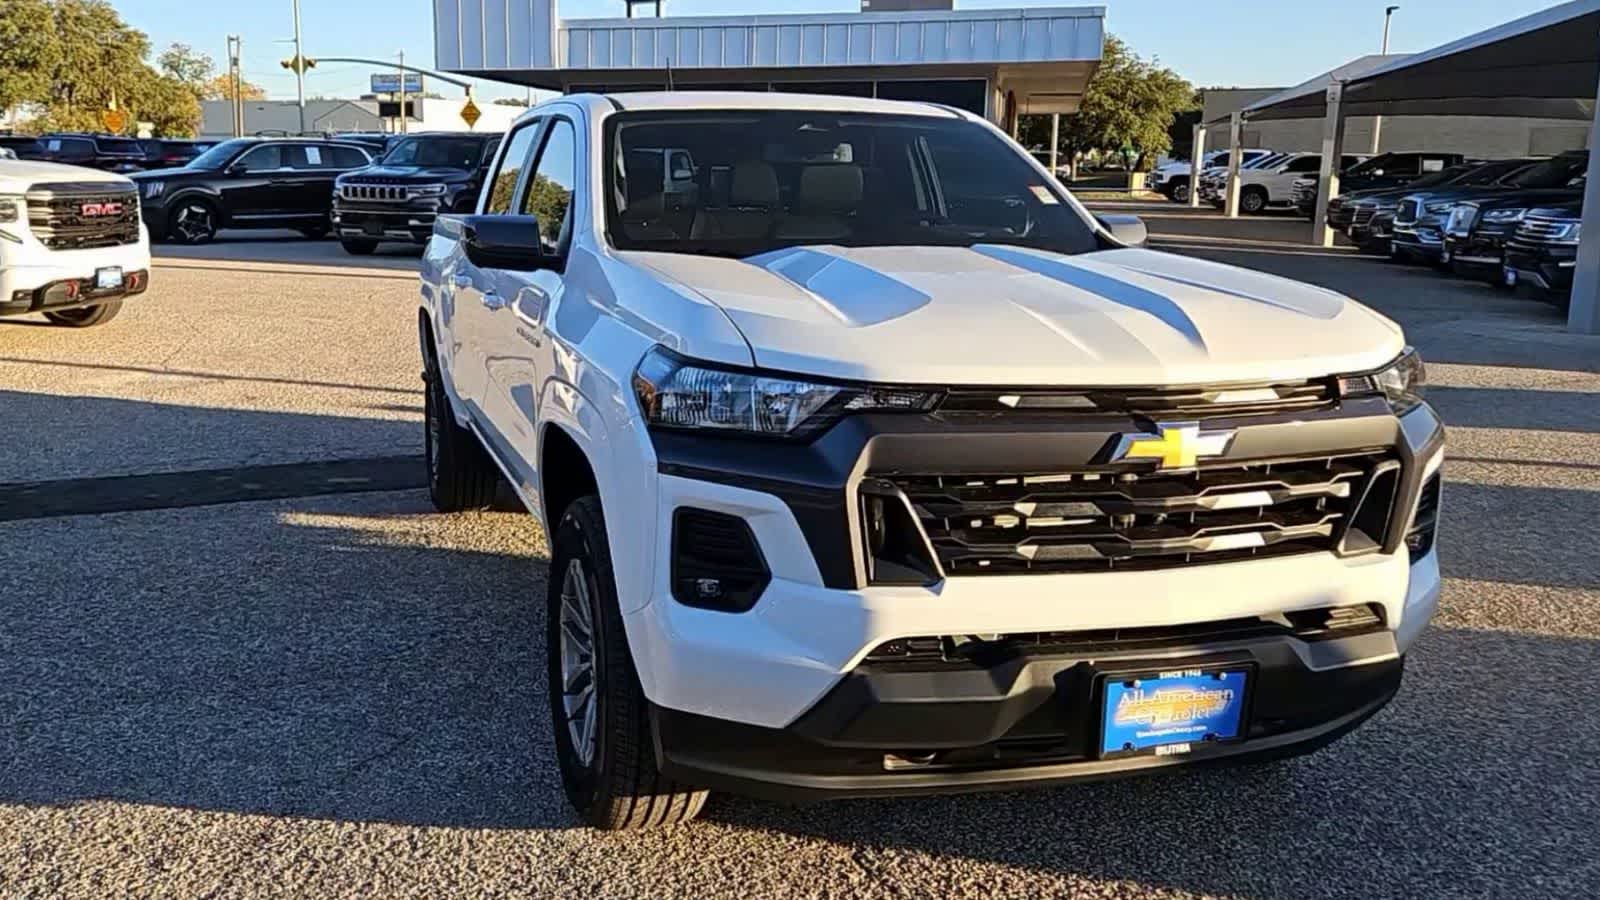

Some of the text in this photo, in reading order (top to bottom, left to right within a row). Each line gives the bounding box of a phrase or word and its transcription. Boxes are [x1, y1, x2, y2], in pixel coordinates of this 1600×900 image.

[82, 203, 122, 216] GMC
[1118, 686, 1234, 708] All American
